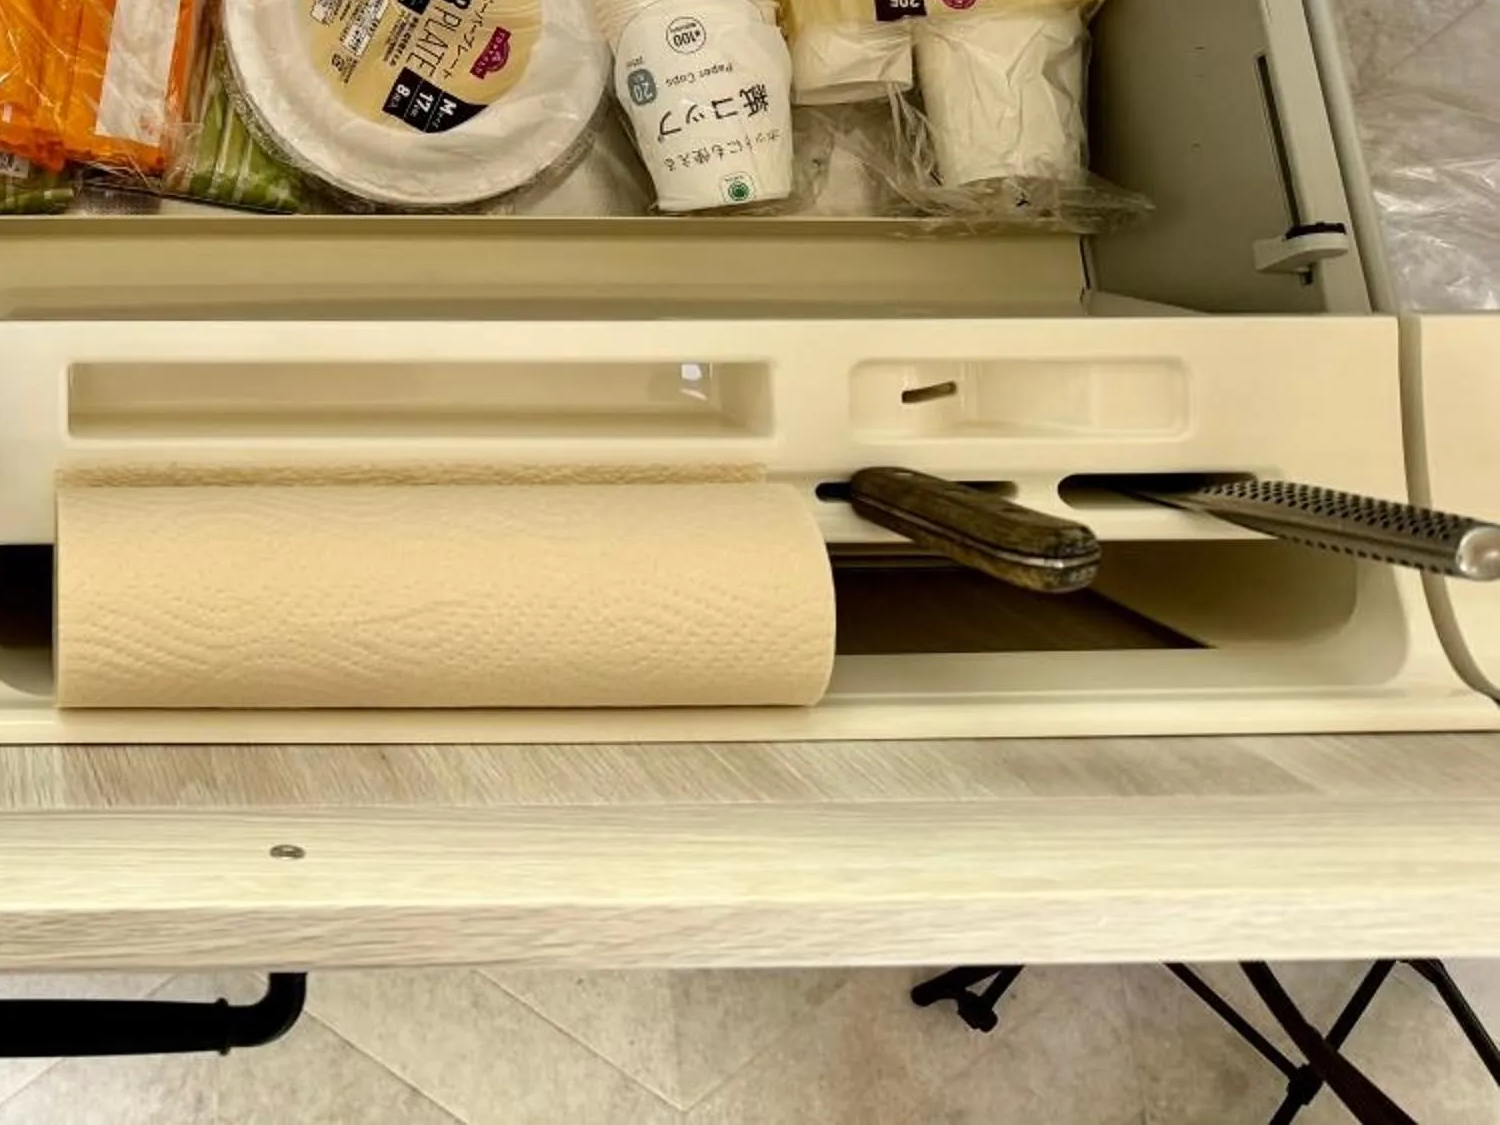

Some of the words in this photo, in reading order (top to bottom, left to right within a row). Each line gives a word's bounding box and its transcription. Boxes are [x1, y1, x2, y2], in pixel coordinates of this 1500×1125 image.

[405, 6, 463, 77] PLATE
[657, 83, 769, 145] 紙コップ
